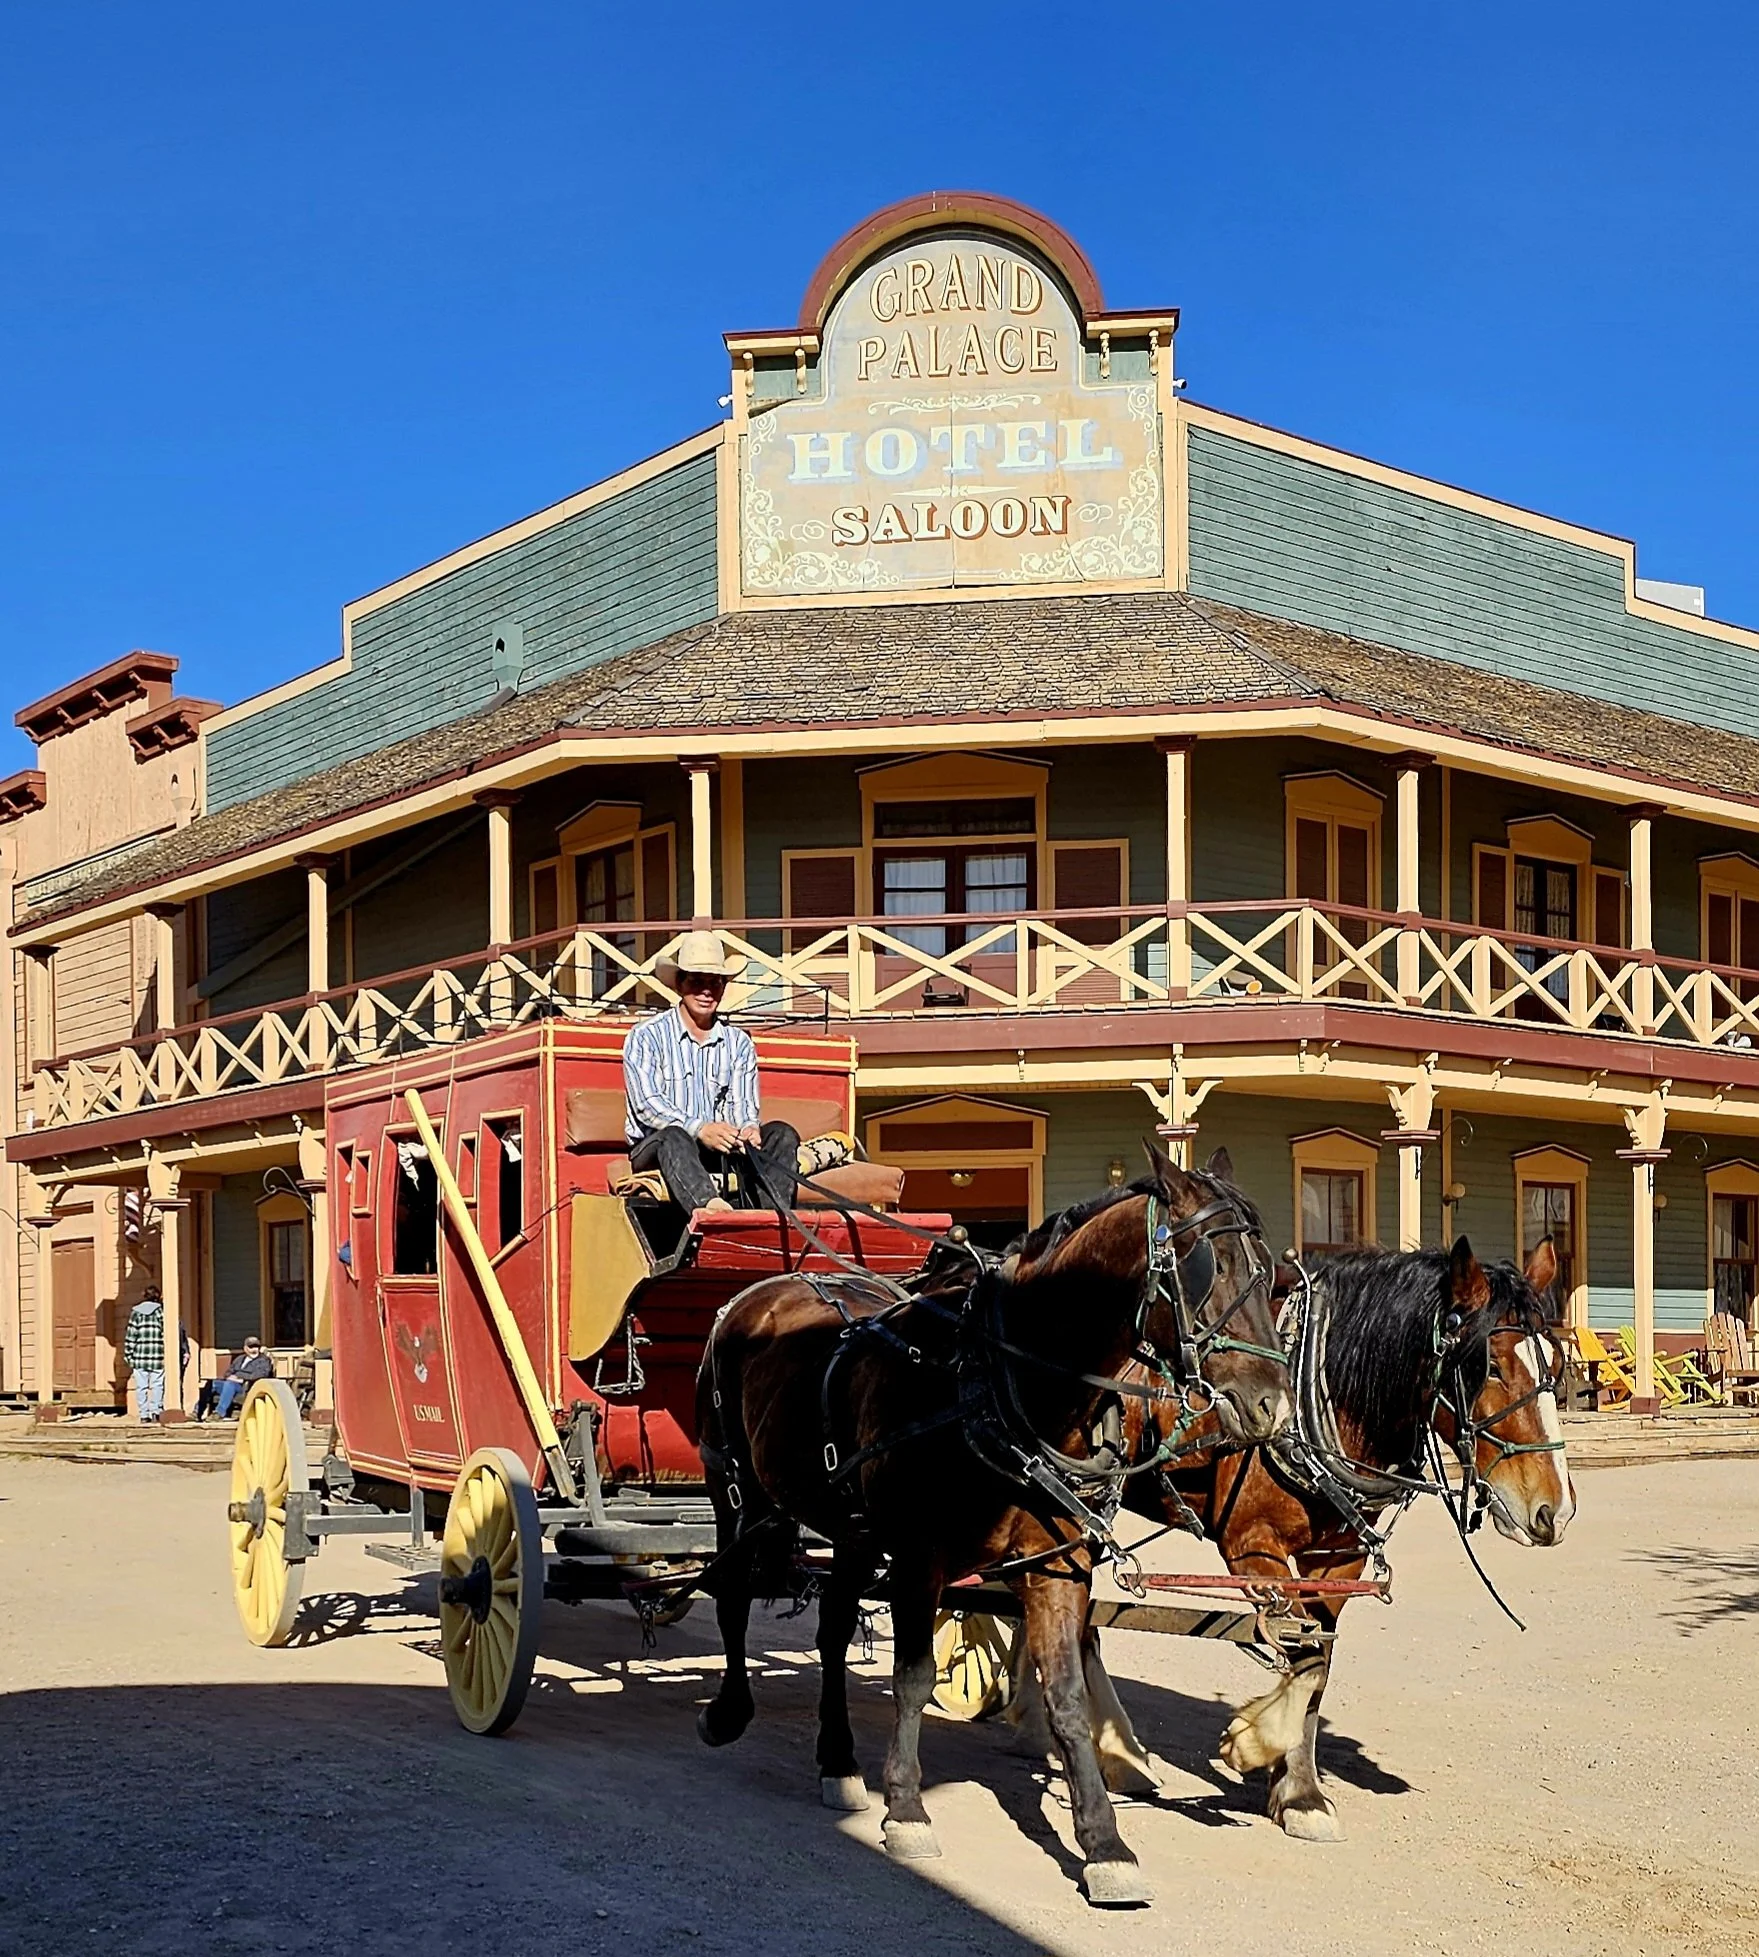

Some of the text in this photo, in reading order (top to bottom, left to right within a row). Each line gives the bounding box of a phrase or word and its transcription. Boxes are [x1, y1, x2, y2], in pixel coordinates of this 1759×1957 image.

[870, 254, 1043, 322] GRAND
[857, 324, 1058, 381] PALACE
[786, 418, 1118, 484] HOTEL
[832, 495, 1071, 546] SALOON
